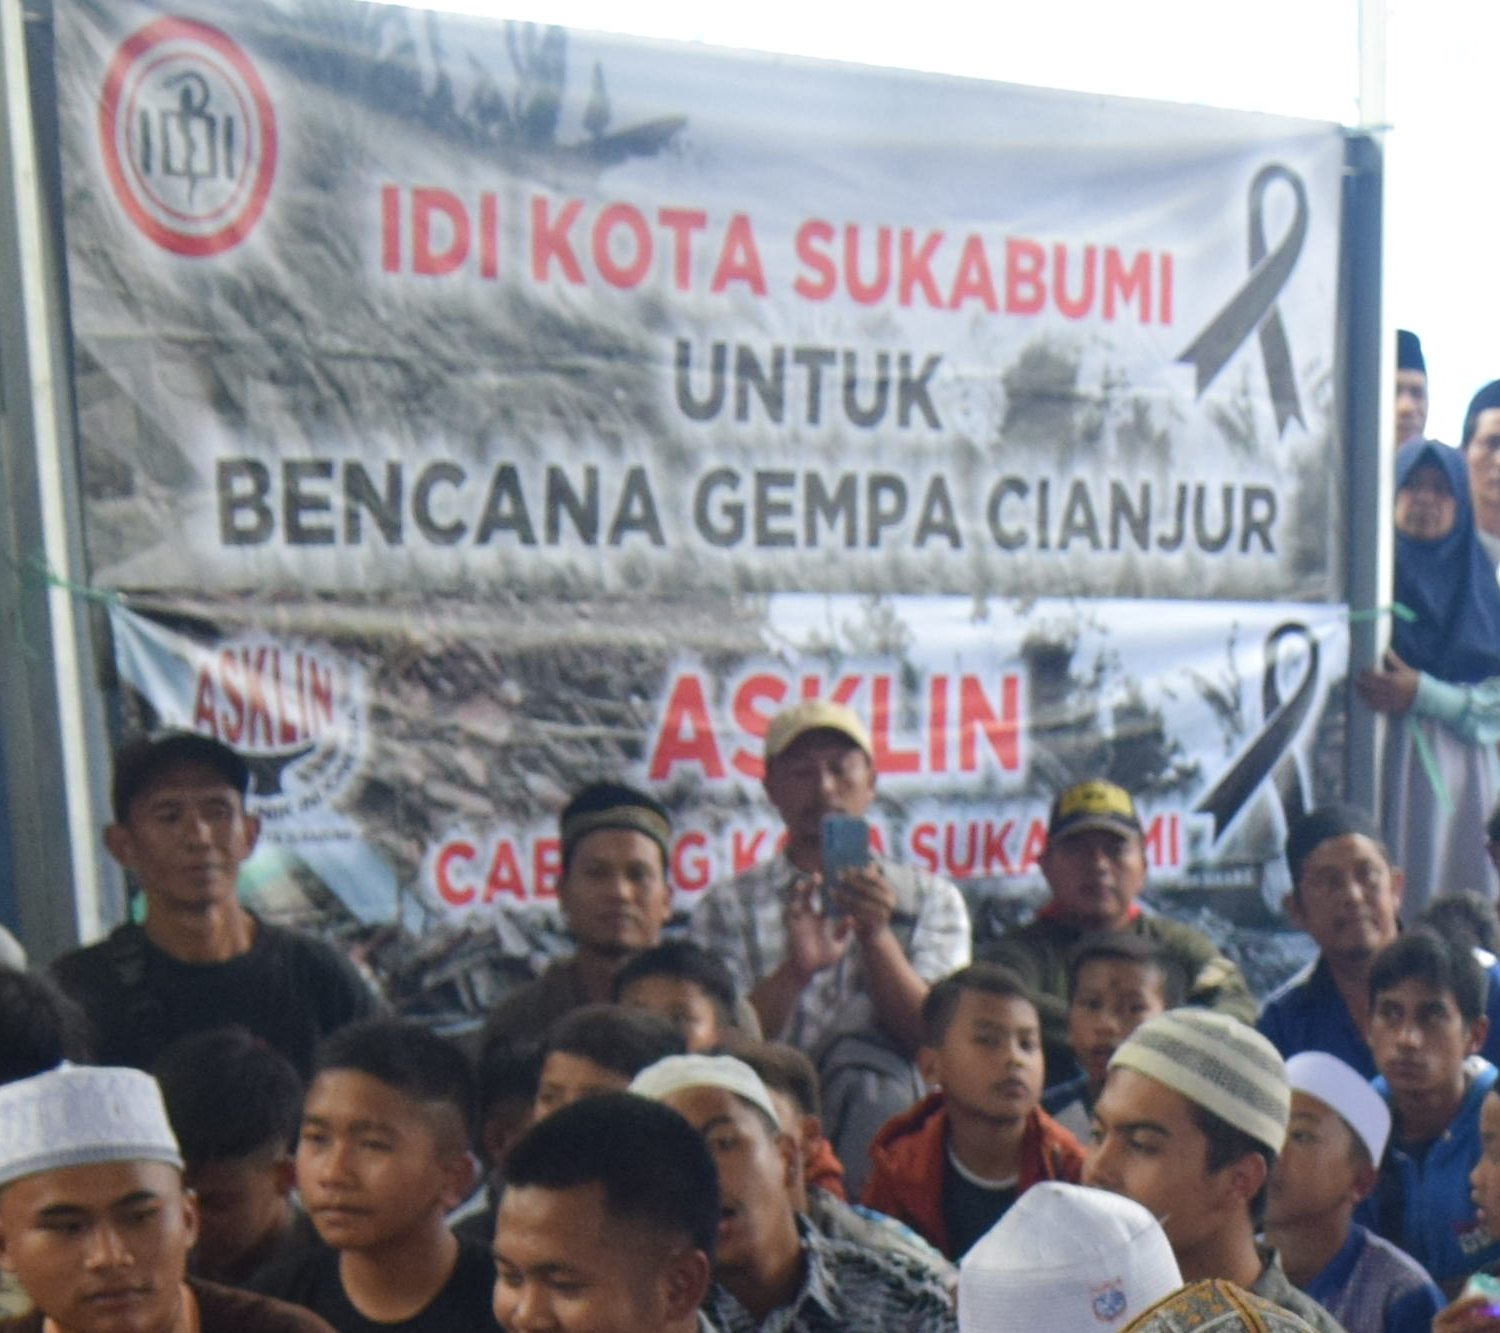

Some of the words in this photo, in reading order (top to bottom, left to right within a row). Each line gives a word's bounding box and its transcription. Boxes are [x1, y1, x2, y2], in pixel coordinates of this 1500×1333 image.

[379, 182, 498, 280] IDI
[529, 194, 768, 298] KOTA
[792, 217, 1176, 326] SUKABUMI
[674, 338, 948, 433] UNTUK
[215, 456, 667, 548] BENCANA
[692, 465, 963, 554] GEMPA
[984, 474, 1281, 556] CIANJUR
[194, 644, 335, 748] ASKLIN
[433, 829, 712, 906] CABG
[910, 812, 1181, 880] SUKAMI
